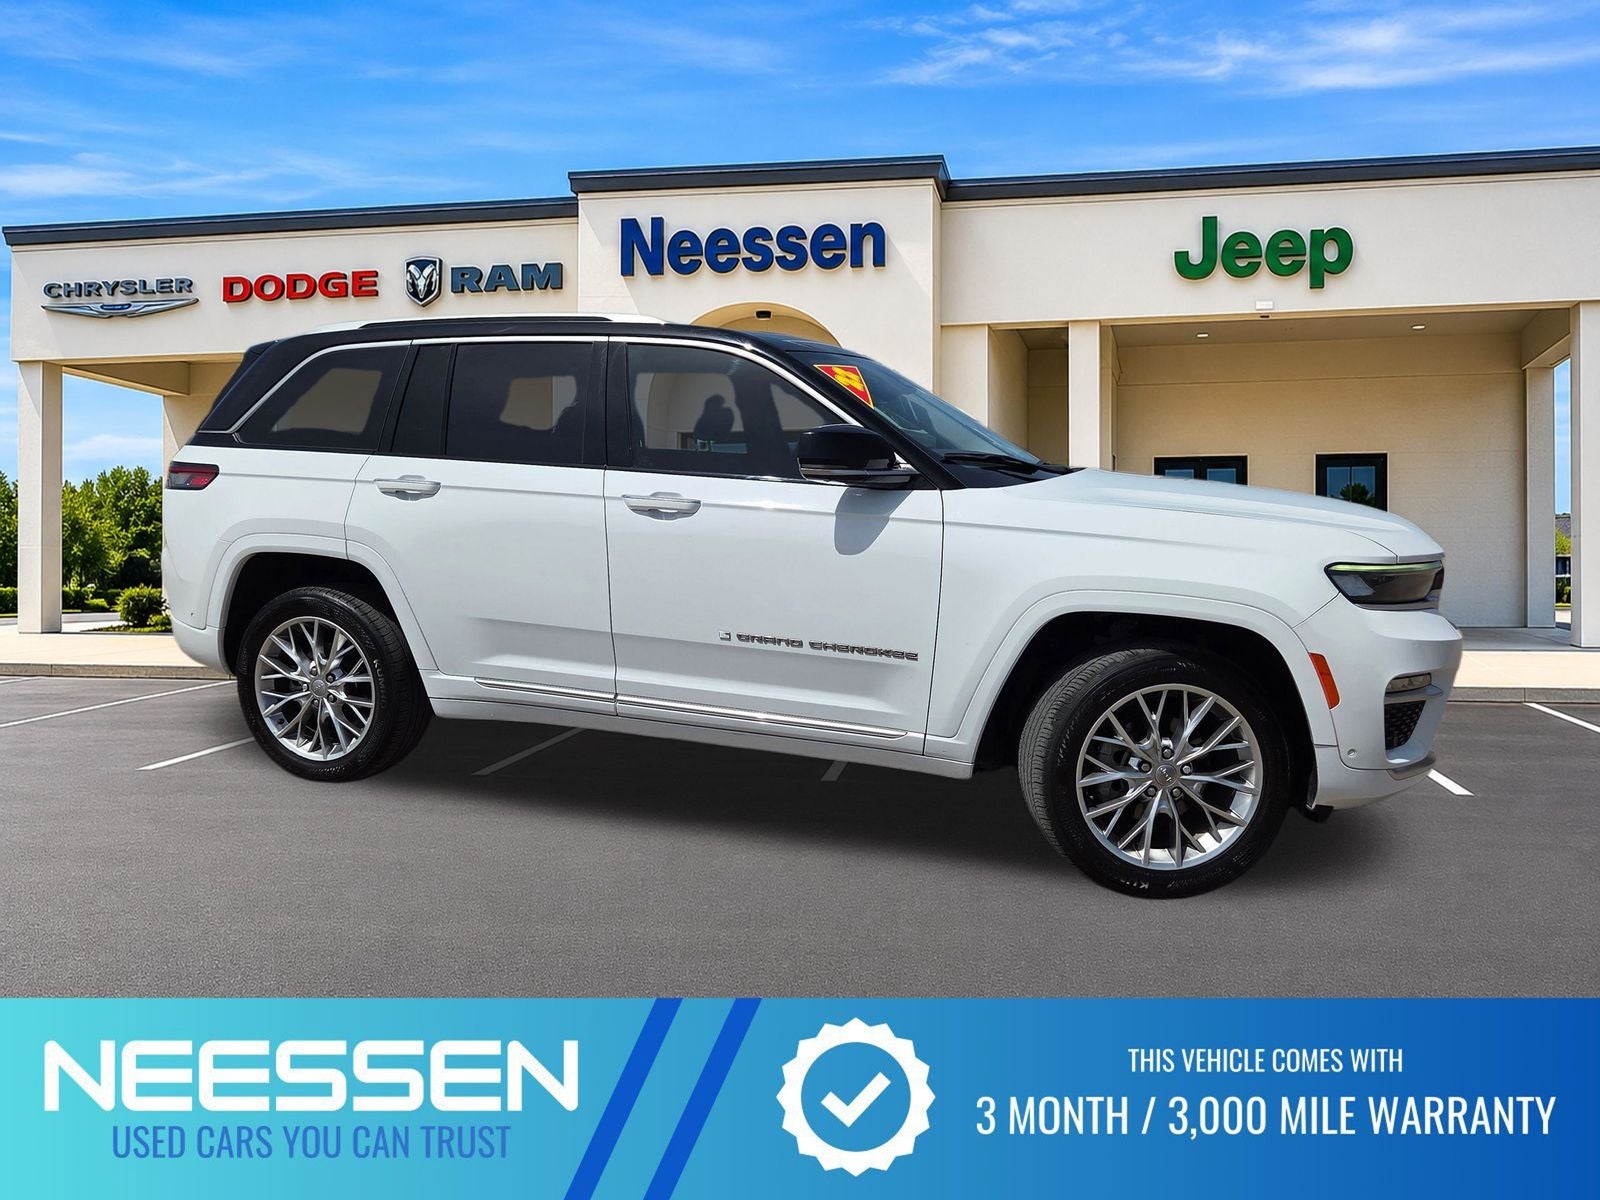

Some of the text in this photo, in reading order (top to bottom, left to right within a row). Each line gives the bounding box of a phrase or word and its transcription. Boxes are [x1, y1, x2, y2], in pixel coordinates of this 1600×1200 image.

[620, 217, 886, 277] Neessen
[1174, 216, 1354, 289] Jeep
[43, 278, 194, 299] CHRYSLER
[222, 270, 378, 303] DODGE
[450, 262, 563, 294] RAM
[736, 632, 919, 662] GRAND CHEROKEE
